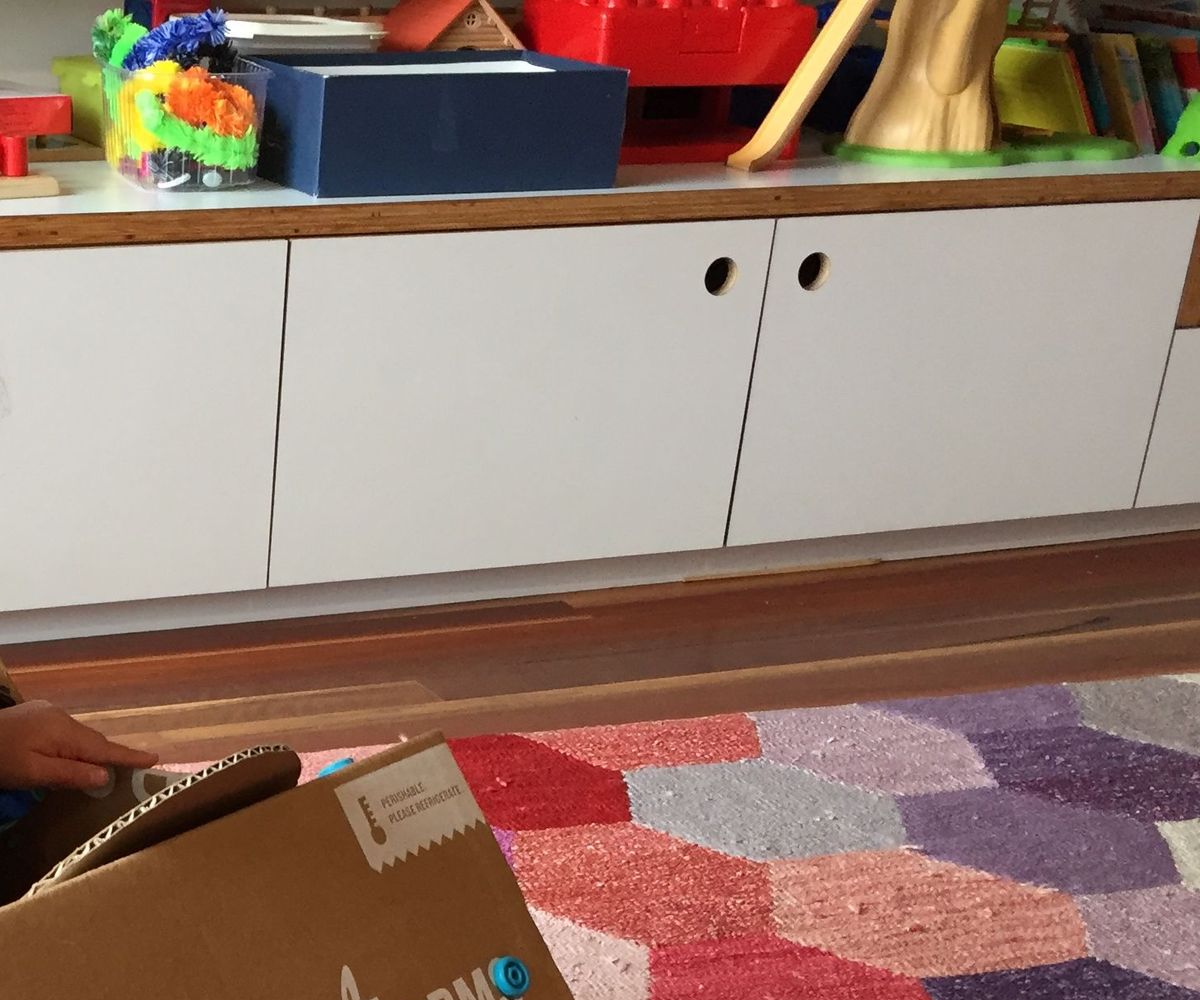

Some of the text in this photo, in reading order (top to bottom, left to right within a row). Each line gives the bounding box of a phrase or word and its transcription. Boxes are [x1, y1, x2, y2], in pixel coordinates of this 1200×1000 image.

[380, 782, 425, 808] PERISHABLE
[388, 785, 462, 824] PLEASE REFRIGERATE
